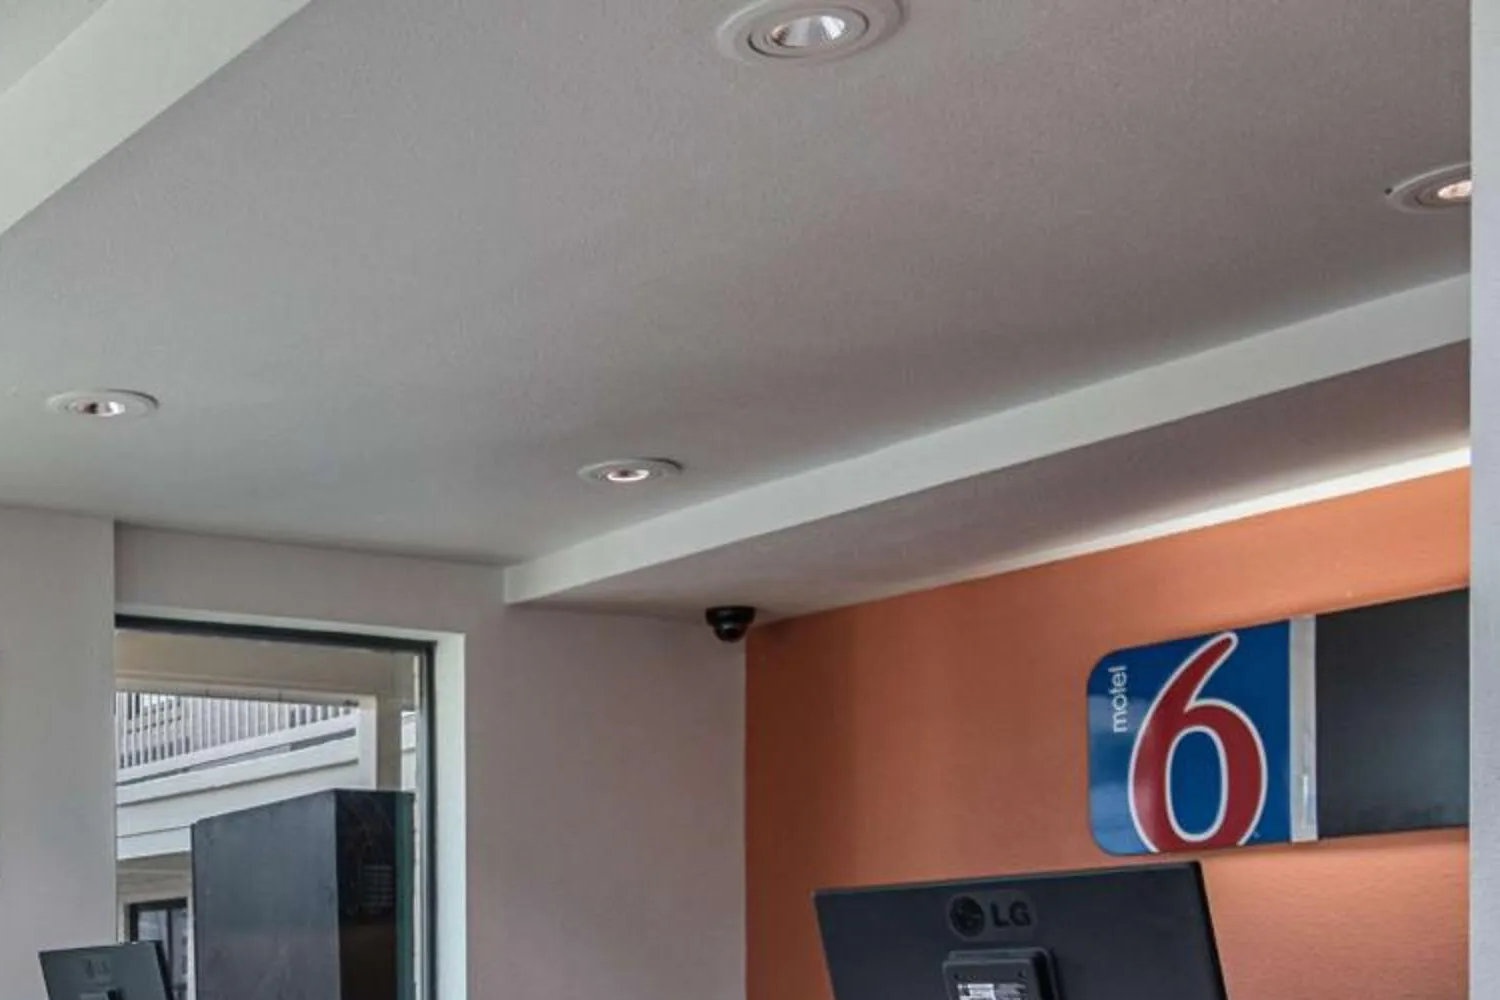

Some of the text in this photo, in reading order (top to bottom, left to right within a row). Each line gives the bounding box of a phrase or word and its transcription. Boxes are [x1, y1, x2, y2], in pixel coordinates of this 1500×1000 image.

[1108, 665, 1129, 733] motel
[1127, 631, 1269, 853] 6
[990, 901, 1031, 927] LG
